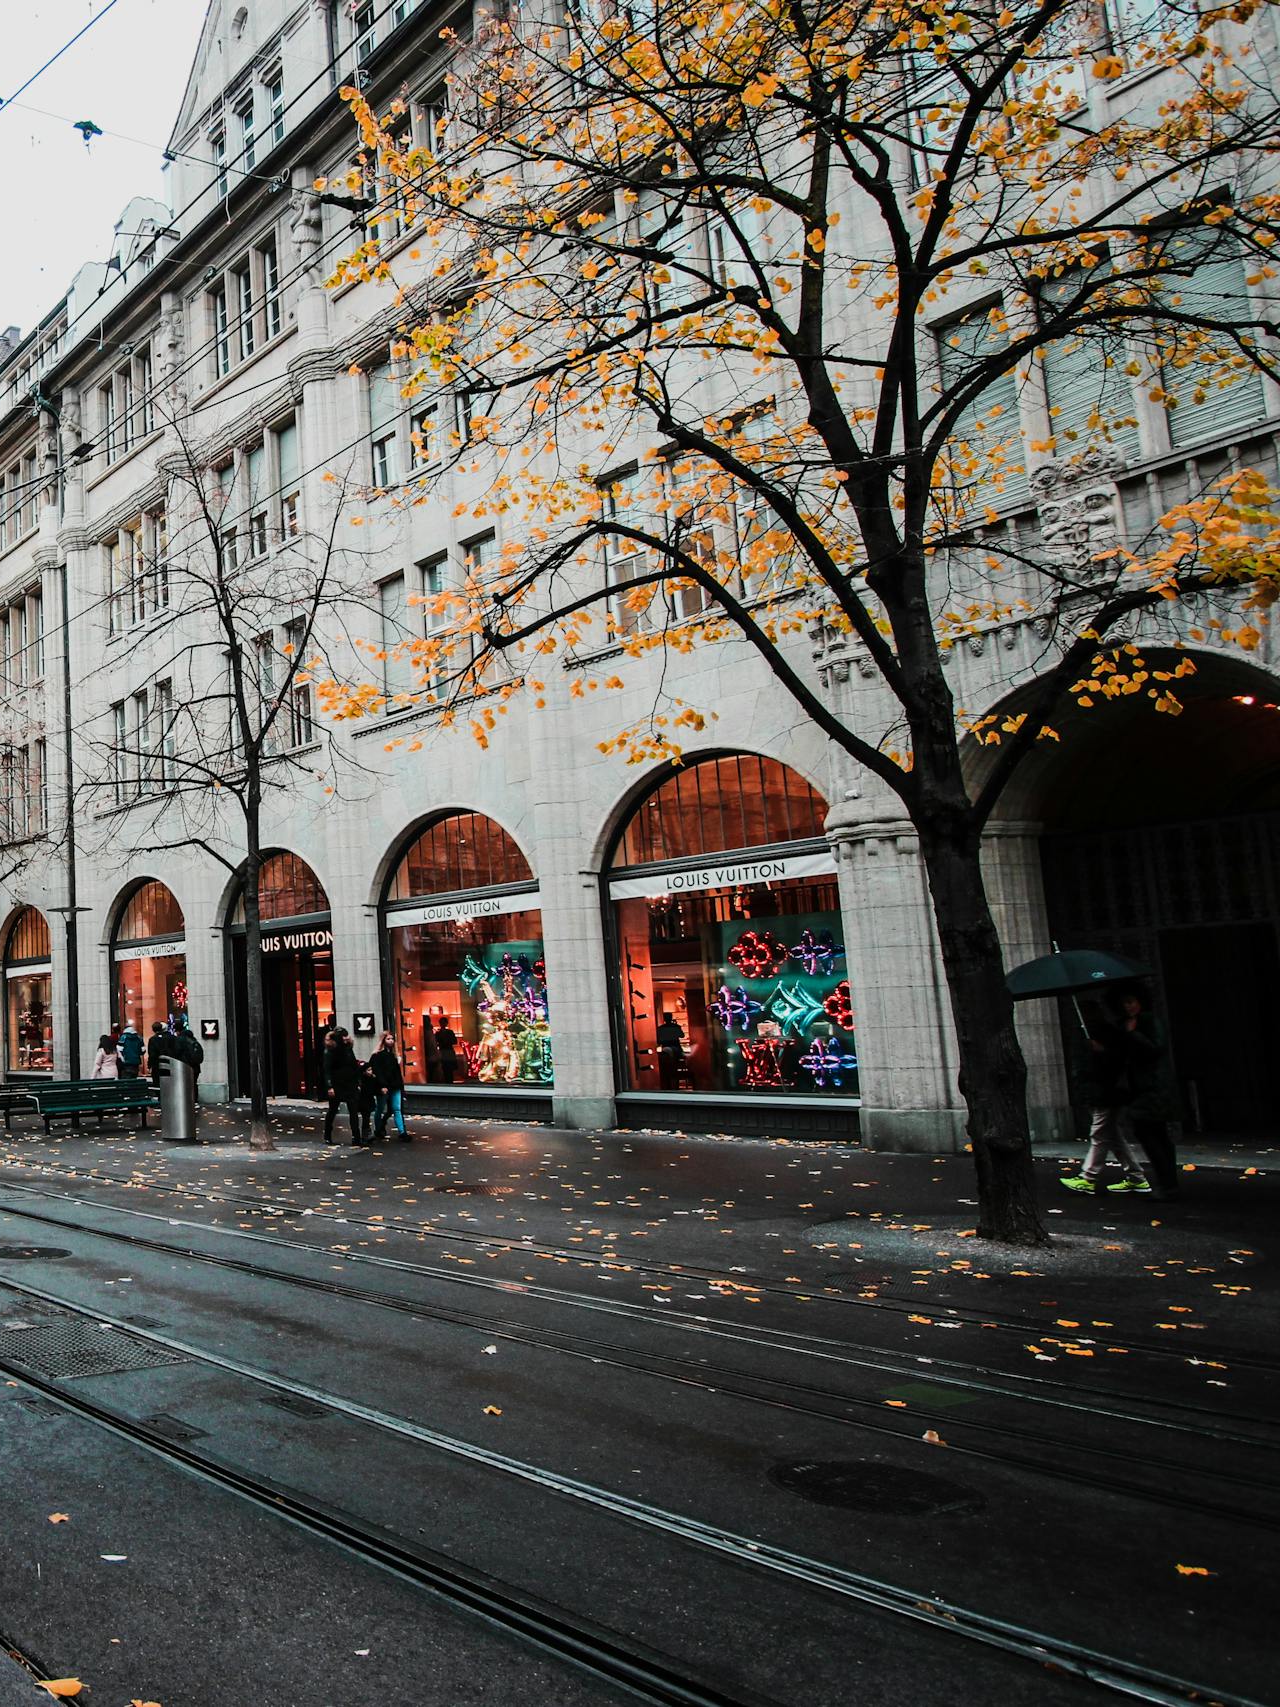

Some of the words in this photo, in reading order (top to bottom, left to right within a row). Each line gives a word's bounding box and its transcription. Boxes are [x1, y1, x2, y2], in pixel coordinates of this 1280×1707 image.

[666, 873, 710, 889] LOUIS
[716, 862, 785, 882] VUITTON
[423, 906, 452, 920] LOUIS
[455, 900, 500, 915] VUITTON
[134, 948, 150, 957] LOUIS
[151, 945, 176, 955] VUITTON
[260, 936, 280, 952] UIS
[283, 930, 334, 949] VUITTON
